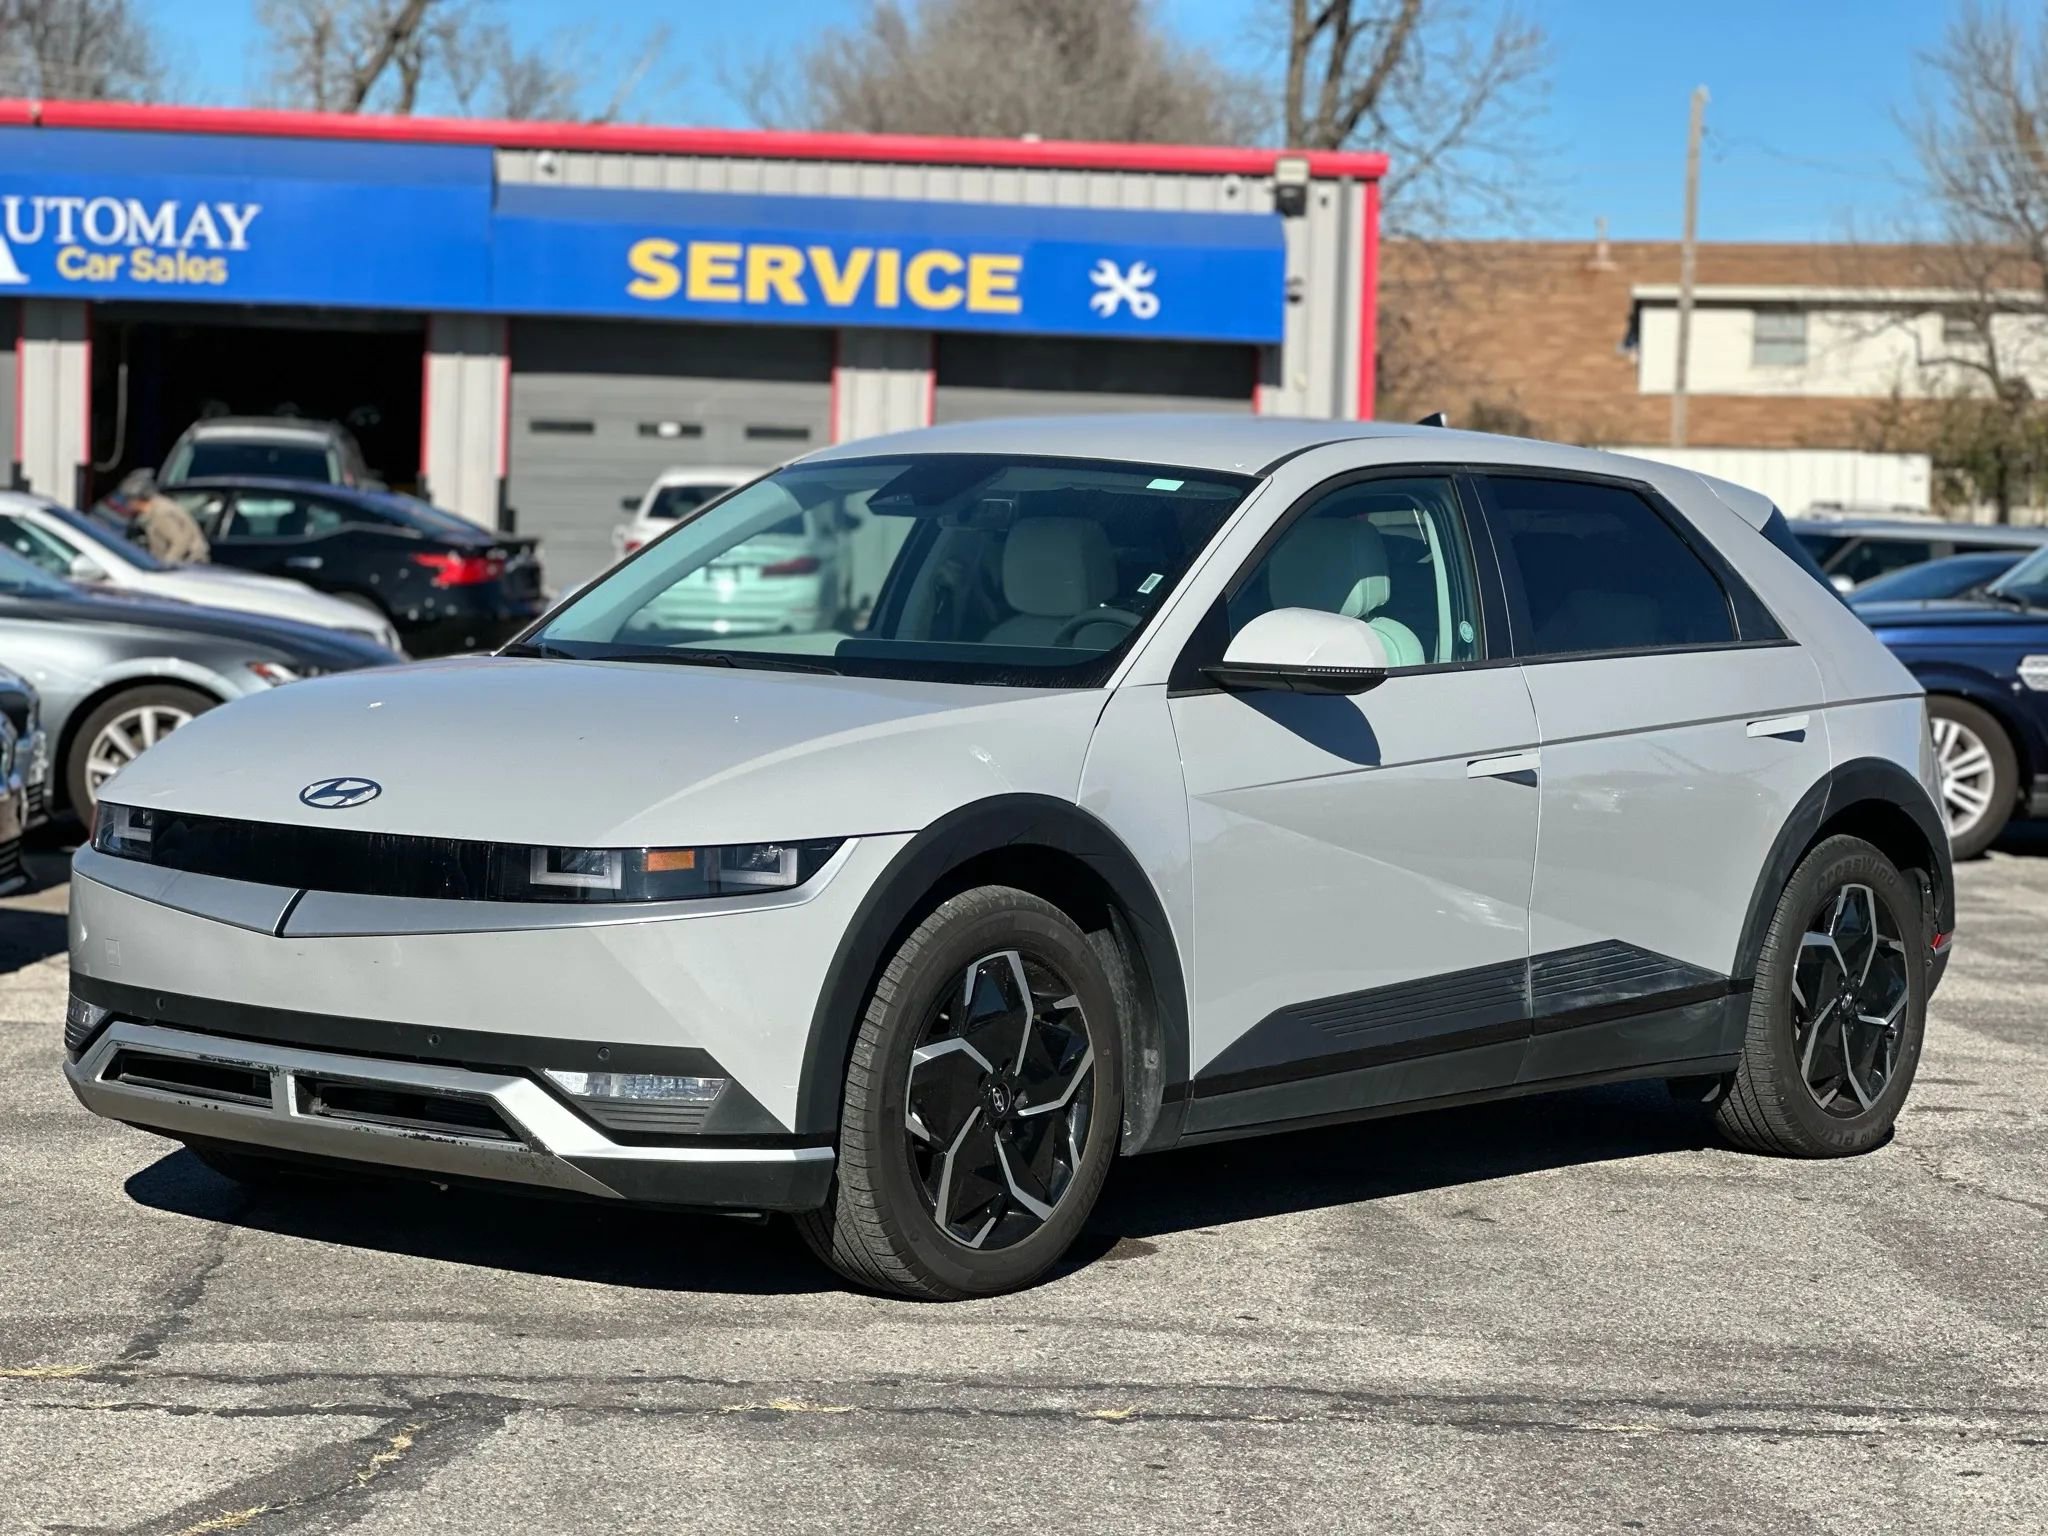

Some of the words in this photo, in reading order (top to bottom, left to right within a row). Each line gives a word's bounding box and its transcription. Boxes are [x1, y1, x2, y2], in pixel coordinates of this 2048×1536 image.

[0, 195, 262, 284] UTOMAY
[56, 246, 124, 281] Car
[130, 247, 228, 285] Sales
[627, 238, 1023, 313] SERVICE
